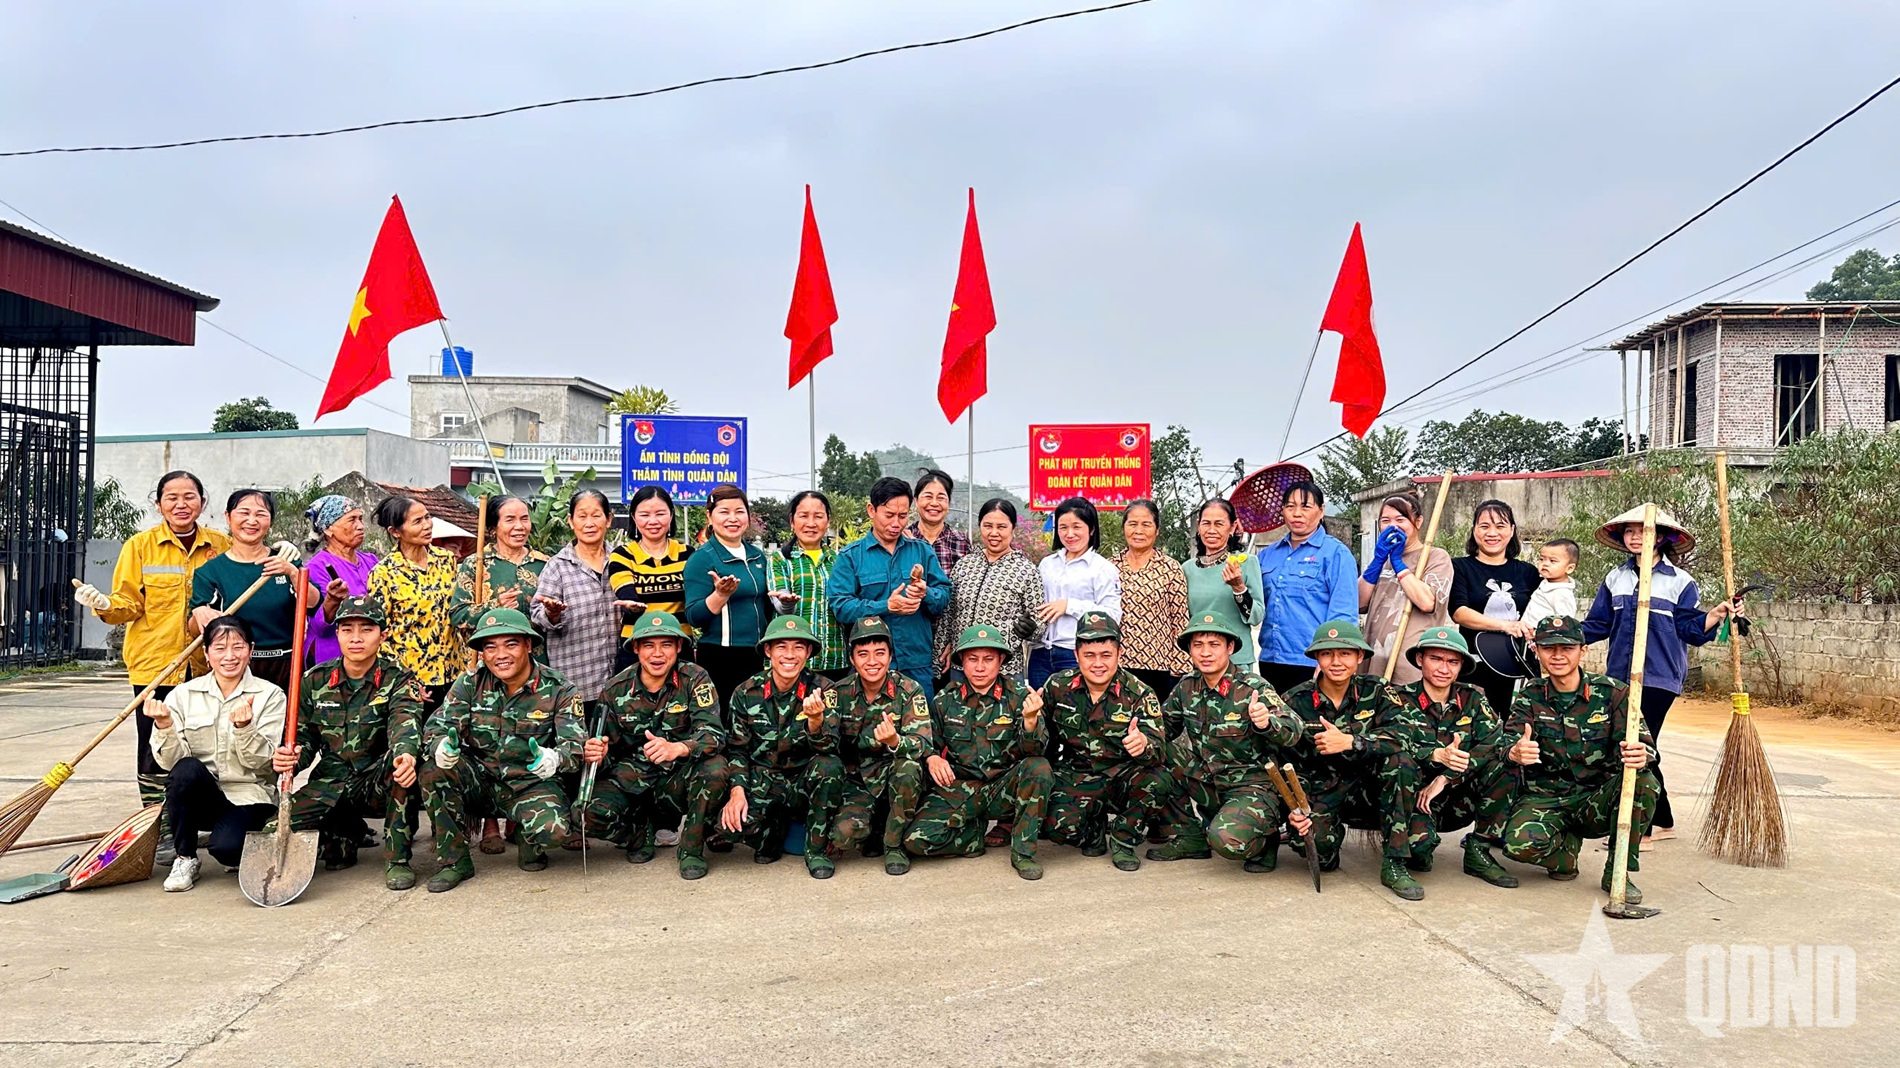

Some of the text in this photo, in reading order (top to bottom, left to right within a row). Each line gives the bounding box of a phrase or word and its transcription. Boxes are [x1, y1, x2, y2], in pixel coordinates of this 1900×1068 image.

[639, 448, 730, 467] ẤM TÌNH ĐỒNG ĐỘI
[1038, 455, 1060, 469] PHÁT
[1062, 457, 1078, 469] HUY
[1114, 453, 1141, 469] THỐNG
[662, 467, 685, 482] TÌNH
[687, 468, 714, 483] QUÂN
[716, 469, 738, 483] DÂN
[1073, 472, 1088, 487] KẾT
[1089, 473, 1113, 488] QUÂN
[1115, 473, 1132, 487] DÂN
[644, 583, 685, 592] RILES
